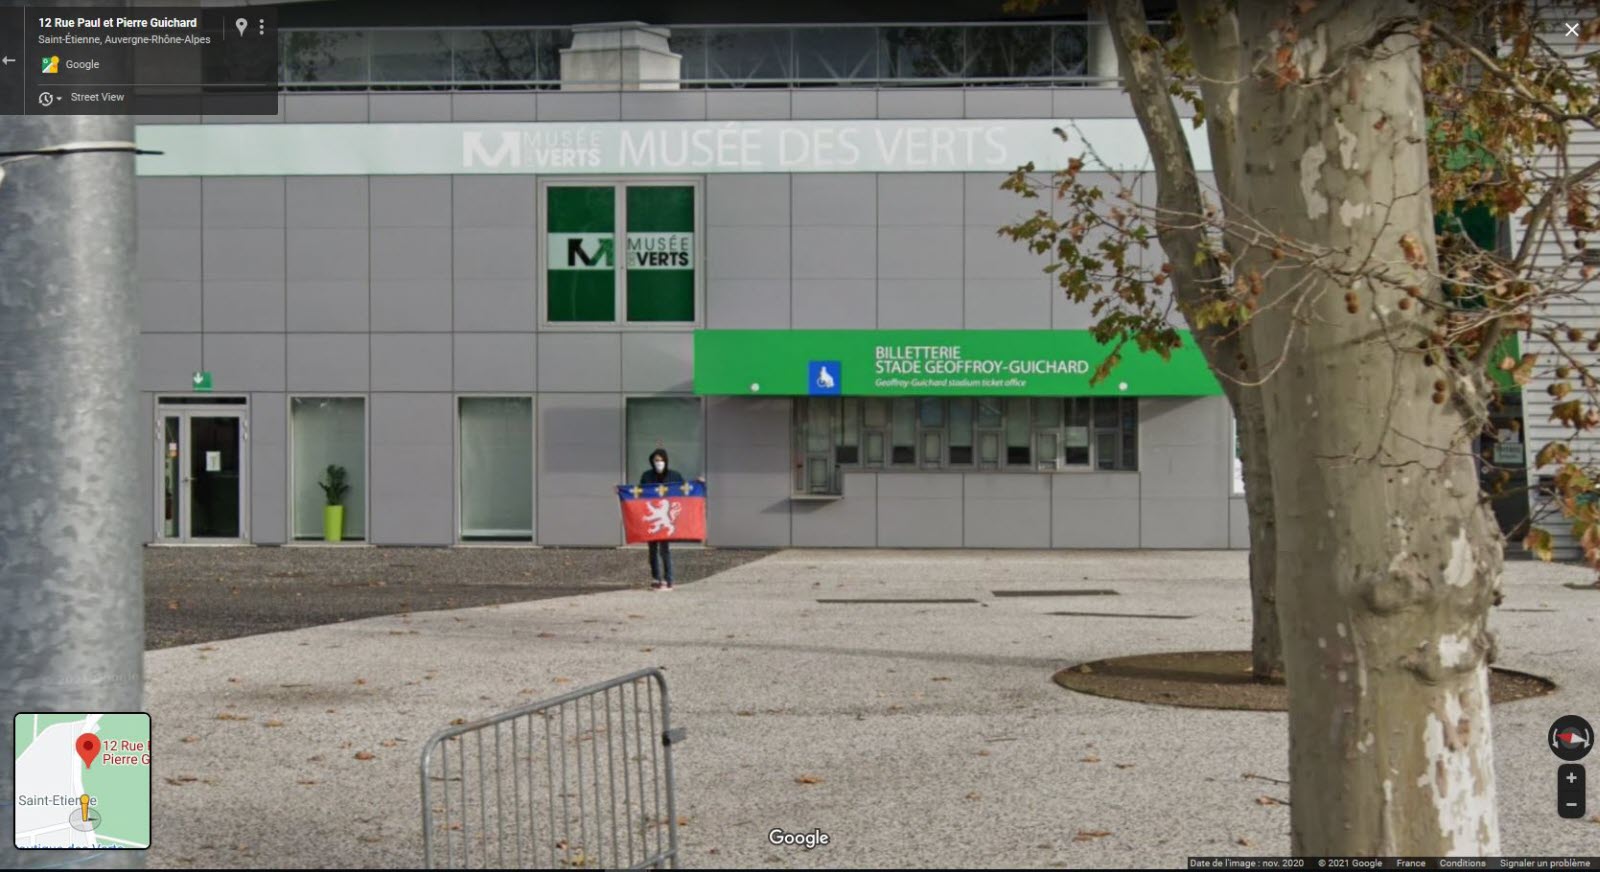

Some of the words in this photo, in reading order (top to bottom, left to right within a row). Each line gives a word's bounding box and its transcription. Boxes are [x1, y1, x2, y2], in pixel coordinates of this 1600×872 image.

[523, 127, 601, 147] MUSÉE
[619, 122, 762, 168] MUSÉE
[779, 127, 861, 167] DES
[874, 126, 1008, 166] VERTS
[536, 149, 601, 168] VERTS
[627, 235, 689, 251] MUSÉE
[636, 252, 689, 266] VERTS
[875, 346, 961, 360] BILLETTERIE
[875, 360, 921, 374] STADE
[924, 360, 1089, 374] GEOFFROY-GUICHARD
[875, 378, 948, 388] Geoffroy-Guichard
[948, 378, 980, 387] stadium
[982, 378, 1004, 387] ticket
[1004, 378, 1027, 387] office
